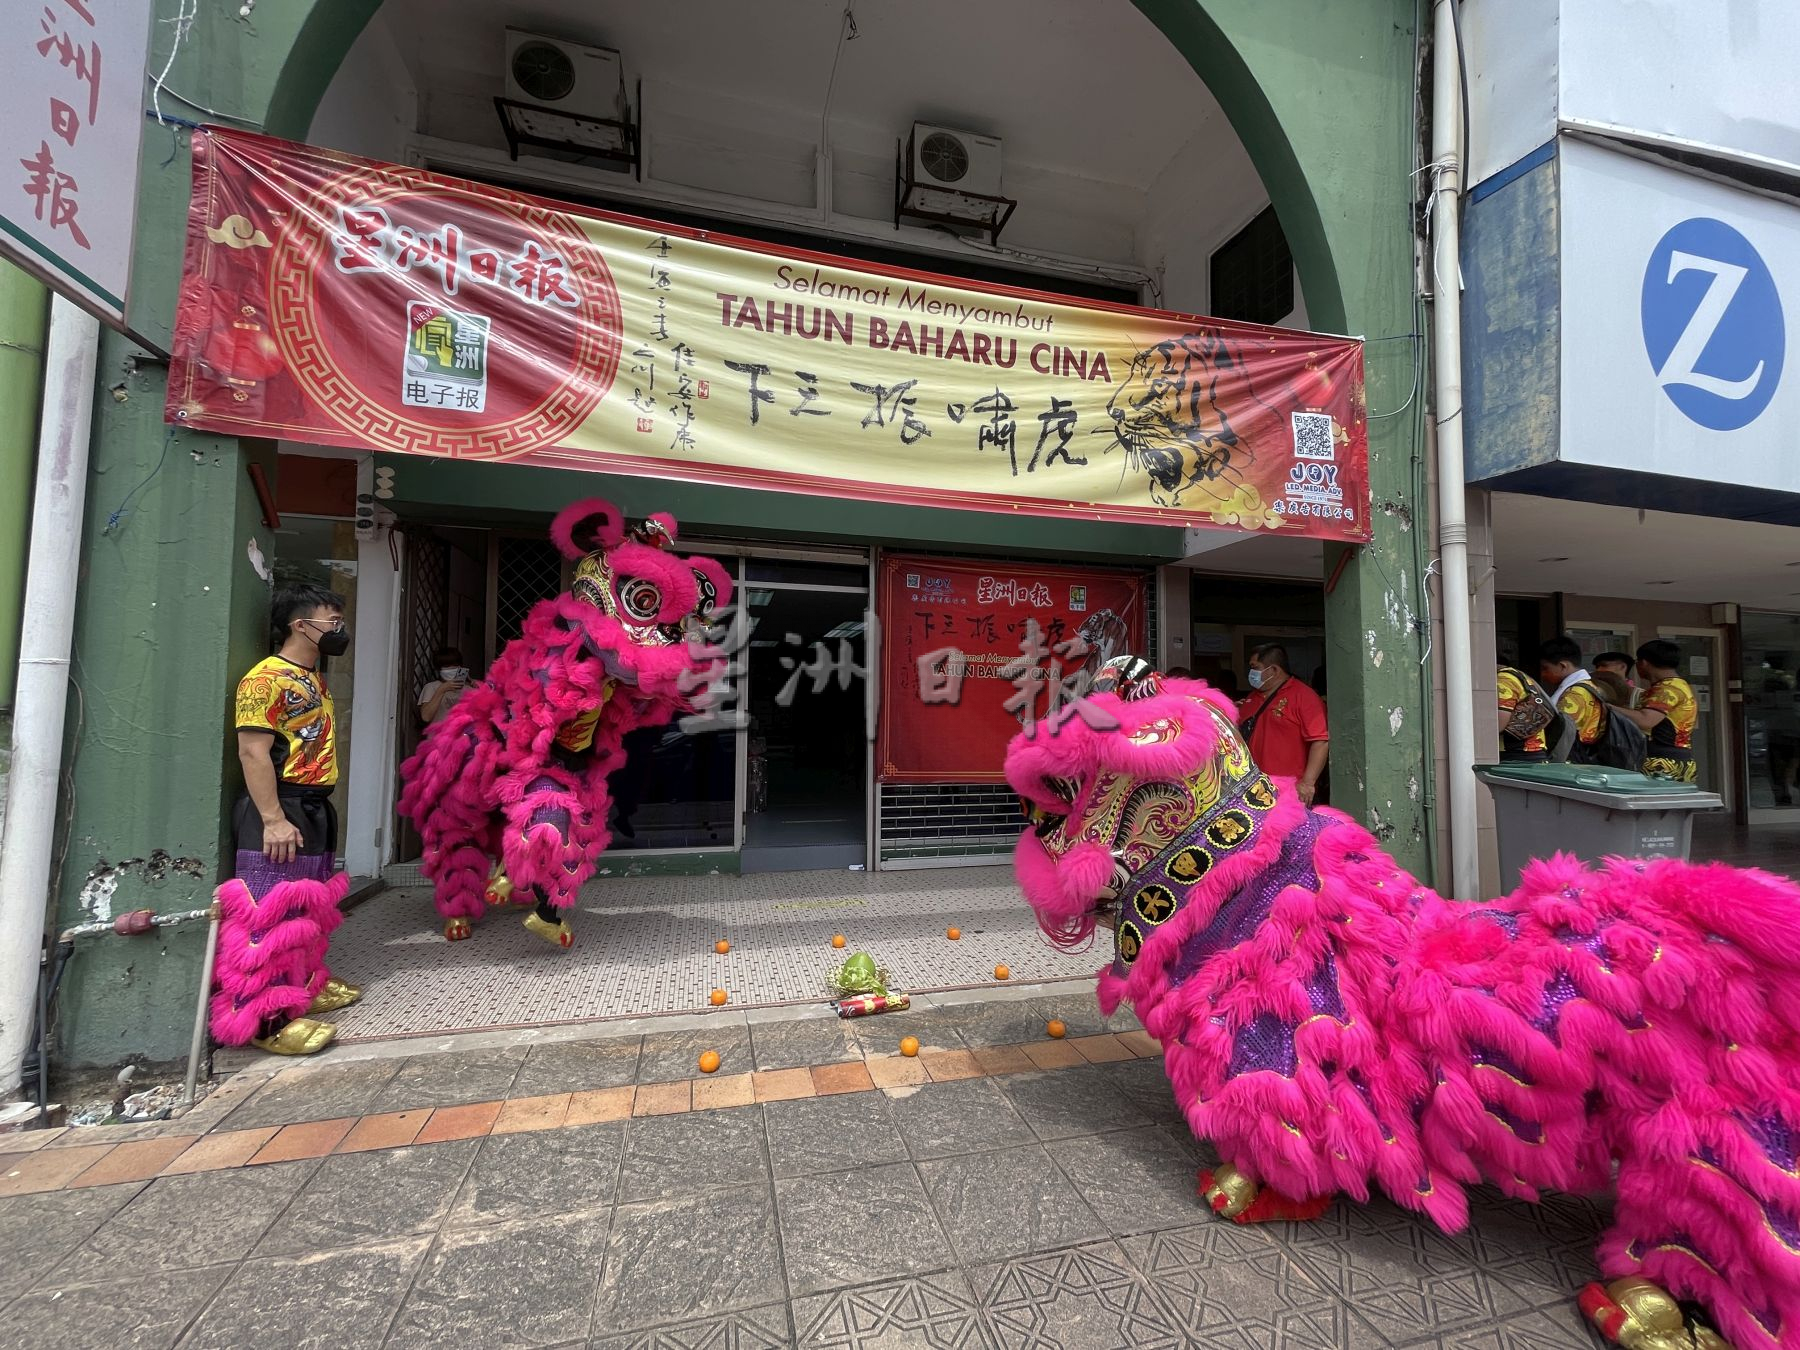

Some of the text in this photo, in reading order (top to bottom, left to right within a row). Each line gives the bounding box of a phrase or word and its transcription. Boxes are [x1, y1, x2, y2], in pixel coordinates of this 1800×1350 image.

[20, 0, 101, 250] 洲日報
[334, 208, 579, 305] 星洲日報
[413, 307, 434, 325] NEW
[773, 265, 1054, 332] Selamat Menyambut
[716, 292, 1112, 383] TAHUN BAHARU CINA
[1655, 249, 1765, 401] Z
[406, 380, 480, 410] 电子报
[1291, 462, 1338, 485] JOY
[977, 576, 1053, 607] 星洲日報
[930, 662, 1061, 681] TAHUN BAHARU CINA
